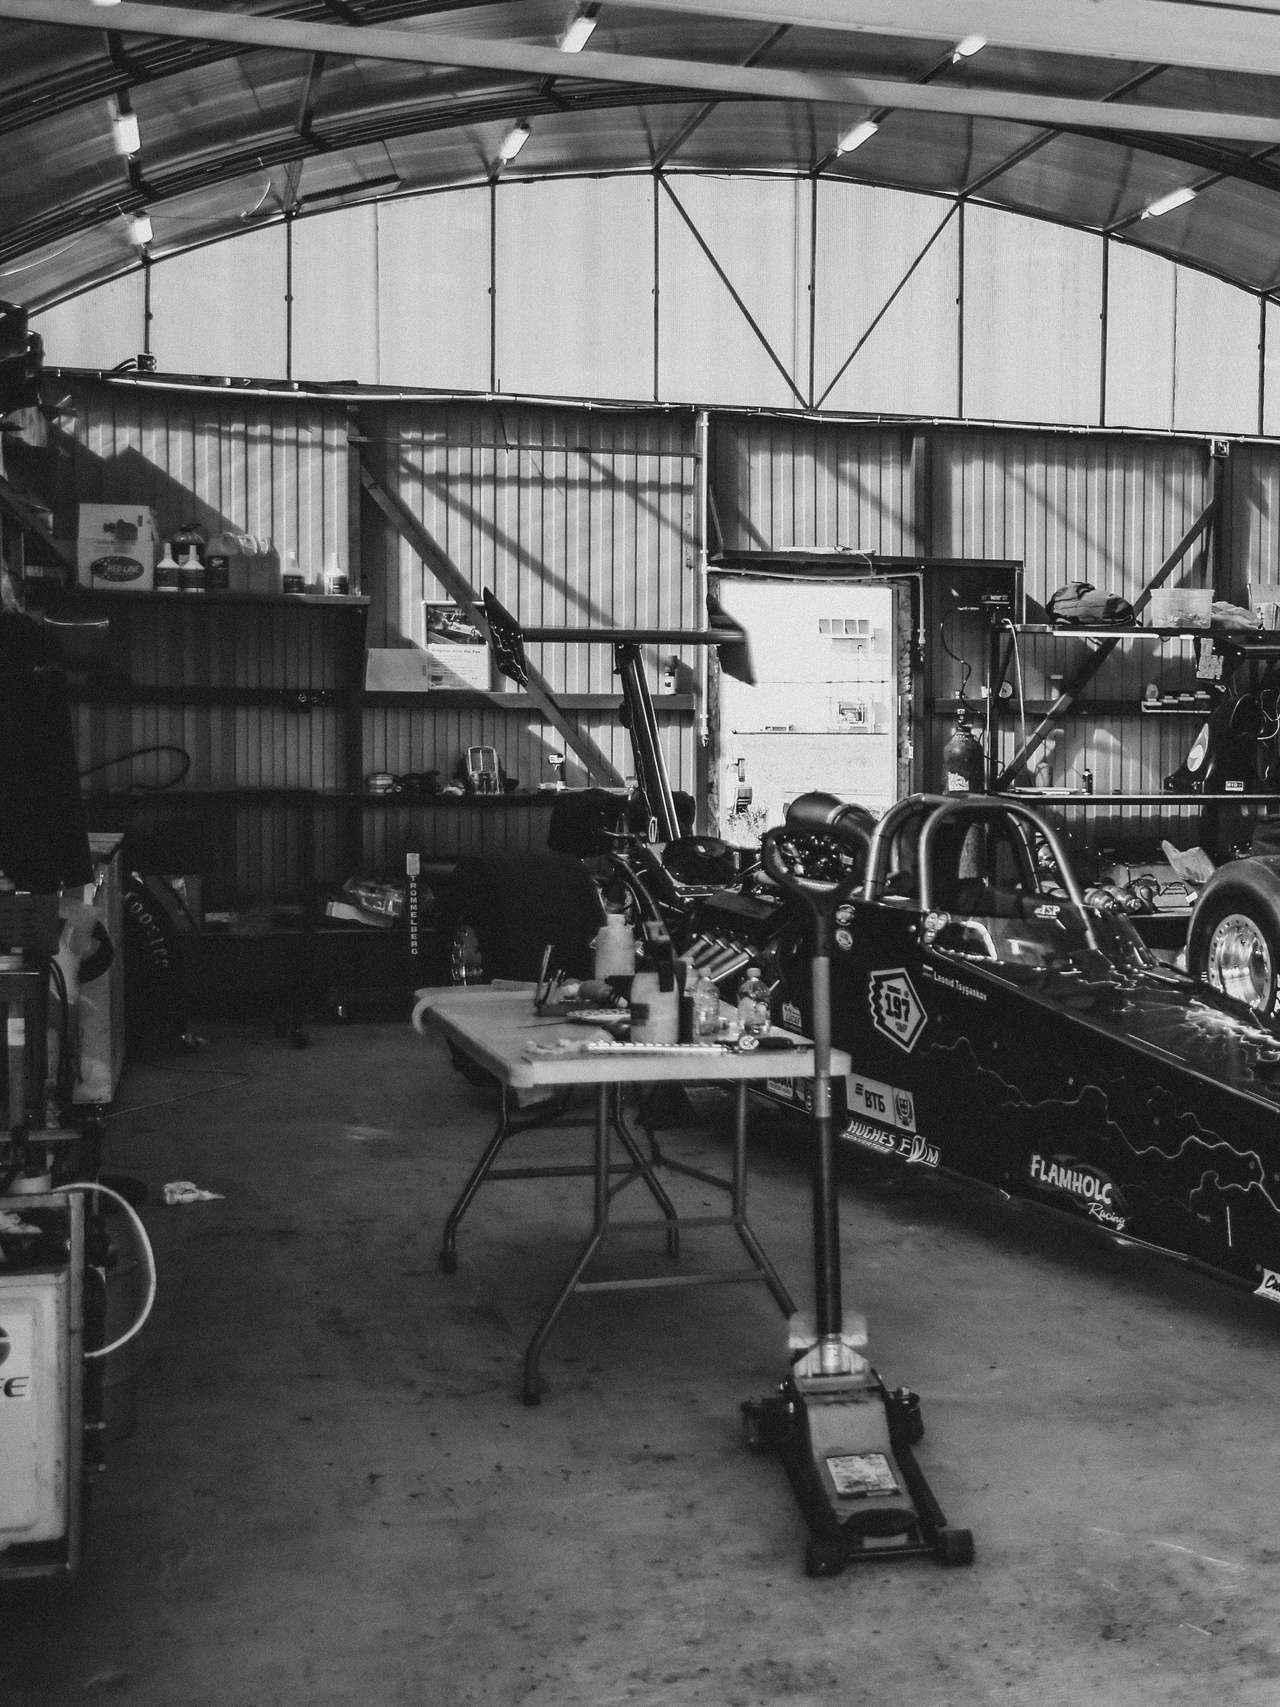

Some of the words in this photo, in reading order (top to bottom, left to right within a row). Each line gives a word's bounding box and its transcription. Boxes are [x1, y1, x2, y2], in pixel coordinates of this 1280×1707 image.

[410, 875, 418, 955] TROMMELBERG
[885, 992, 910, 1023] 197
[864, 1089, 886, 1113] ВТБ
[847, 1120, 897, 1148] HUGHES
[1030, 1154, 1112, 1204] FLAMHOLC
[1087, 1202, 1126, 1231] Racing
